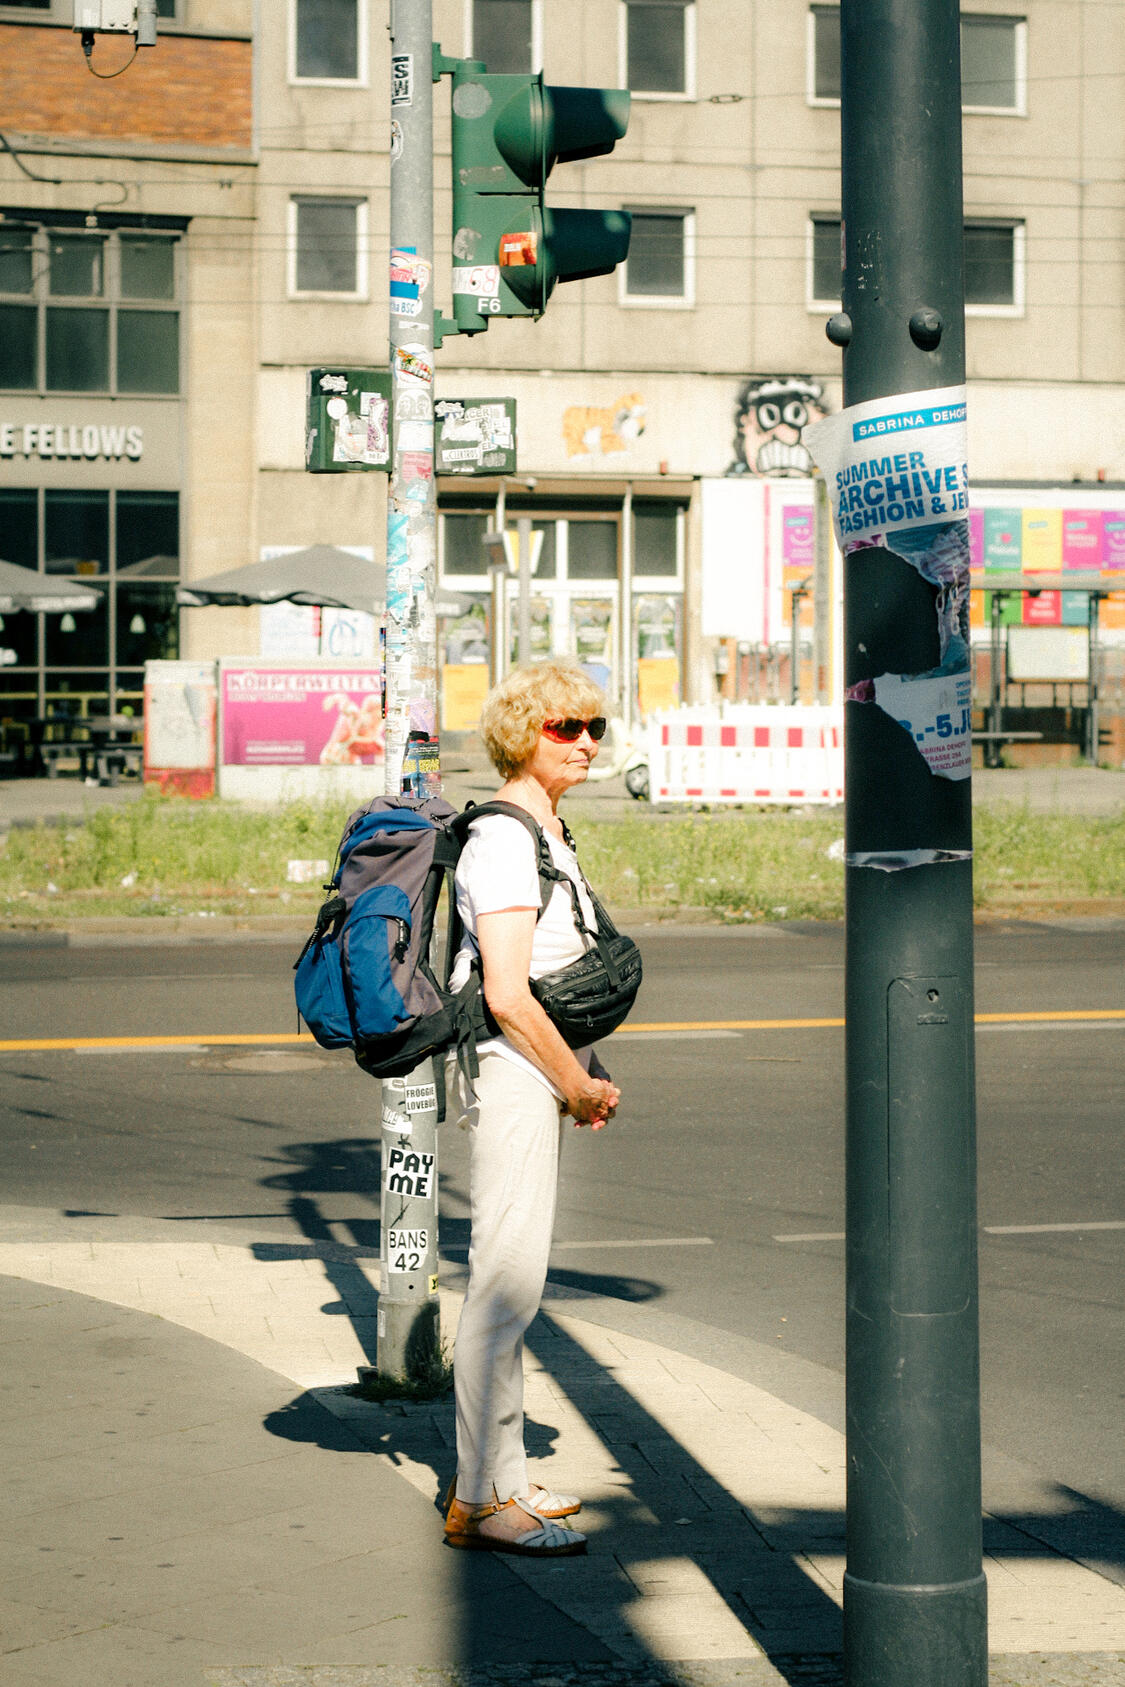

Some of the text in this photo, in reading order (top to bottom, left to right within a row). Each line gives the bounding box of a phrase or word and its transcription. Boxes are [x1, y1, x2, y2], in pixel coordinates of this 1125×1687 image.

[477, 298, 501, 312] F6
[859, 415, 925, 436] SABRINA
[23, 423, 143, 459] FELLOWS
[836, 451, 926, 490] SUMMER
[838, 466, 959, 517] ARCHIVE
[838, 499, 925, 536] FASHION
[931, 496, 947, 515] &
[389, 1149, 434, 1174] PAY
[389, 1173, 428, 1197] ME
[389, 1231, 427, 1249] BANS
[395, 1253, 420, 1271] 42
